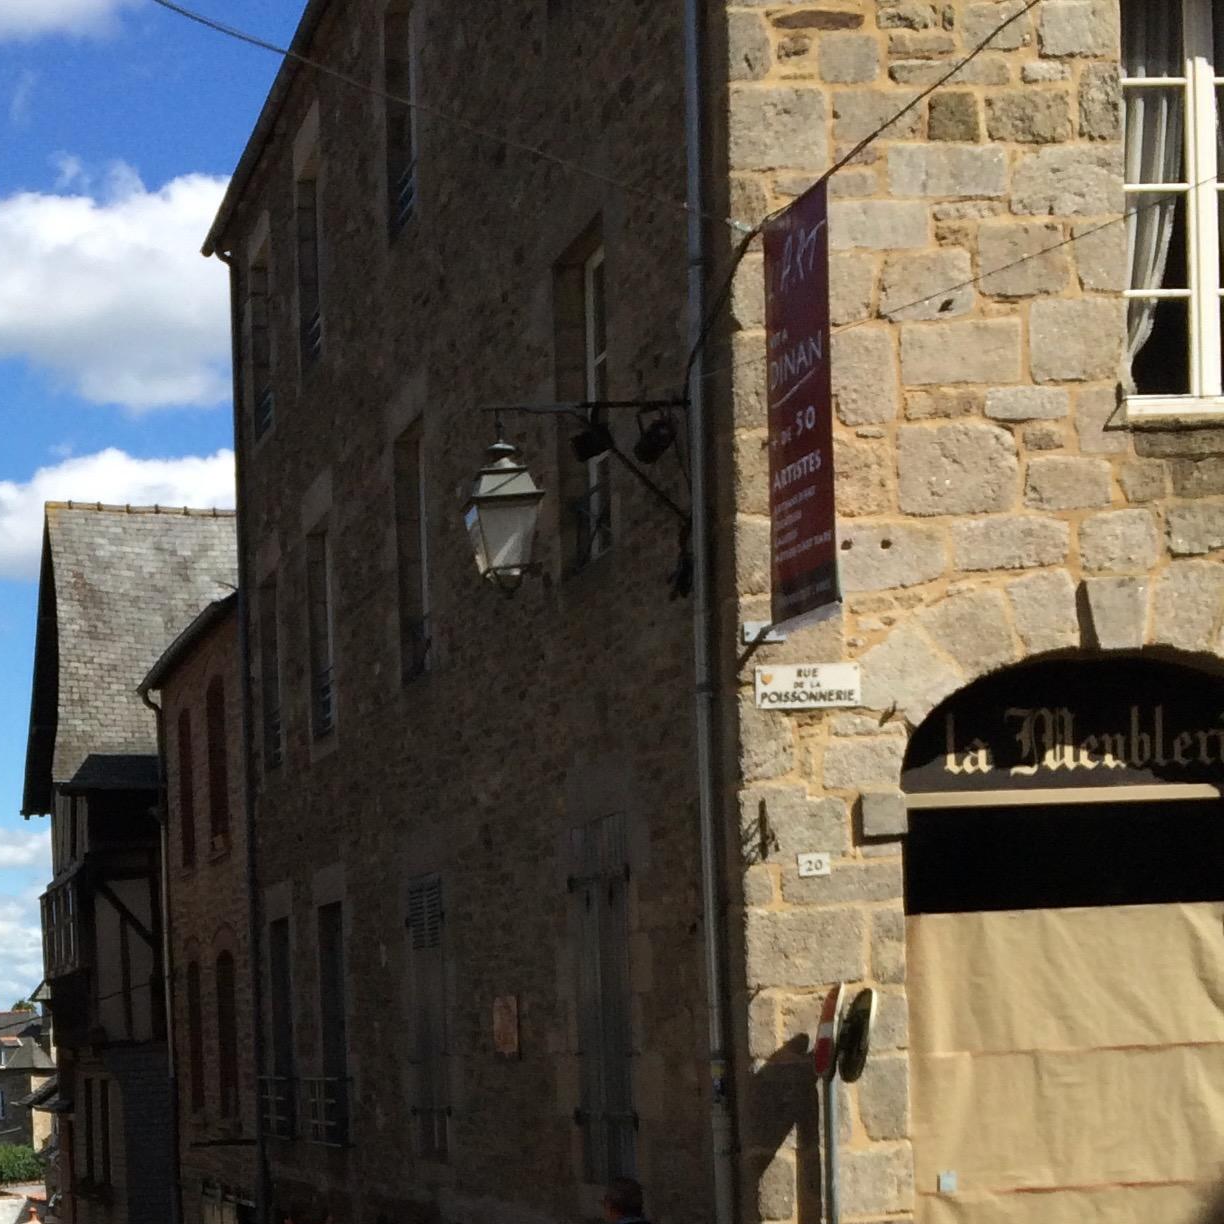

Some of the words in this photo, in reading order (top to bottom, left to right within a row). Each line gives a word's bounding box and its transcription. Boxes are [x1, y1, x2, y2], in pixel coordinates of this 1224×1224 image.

[795, 405, 817, 436] 50
[774, 450, 823, 490] ARTISTES
[796, 667, 820, 679] RUE
[793, 681, 805, 689] DE
[810, 681, 821, 689] LA
[760, 689, 855, 704] POISSONNERIE
[944, 712, 994, 776] la
[805, 859, 823, 872] 20
